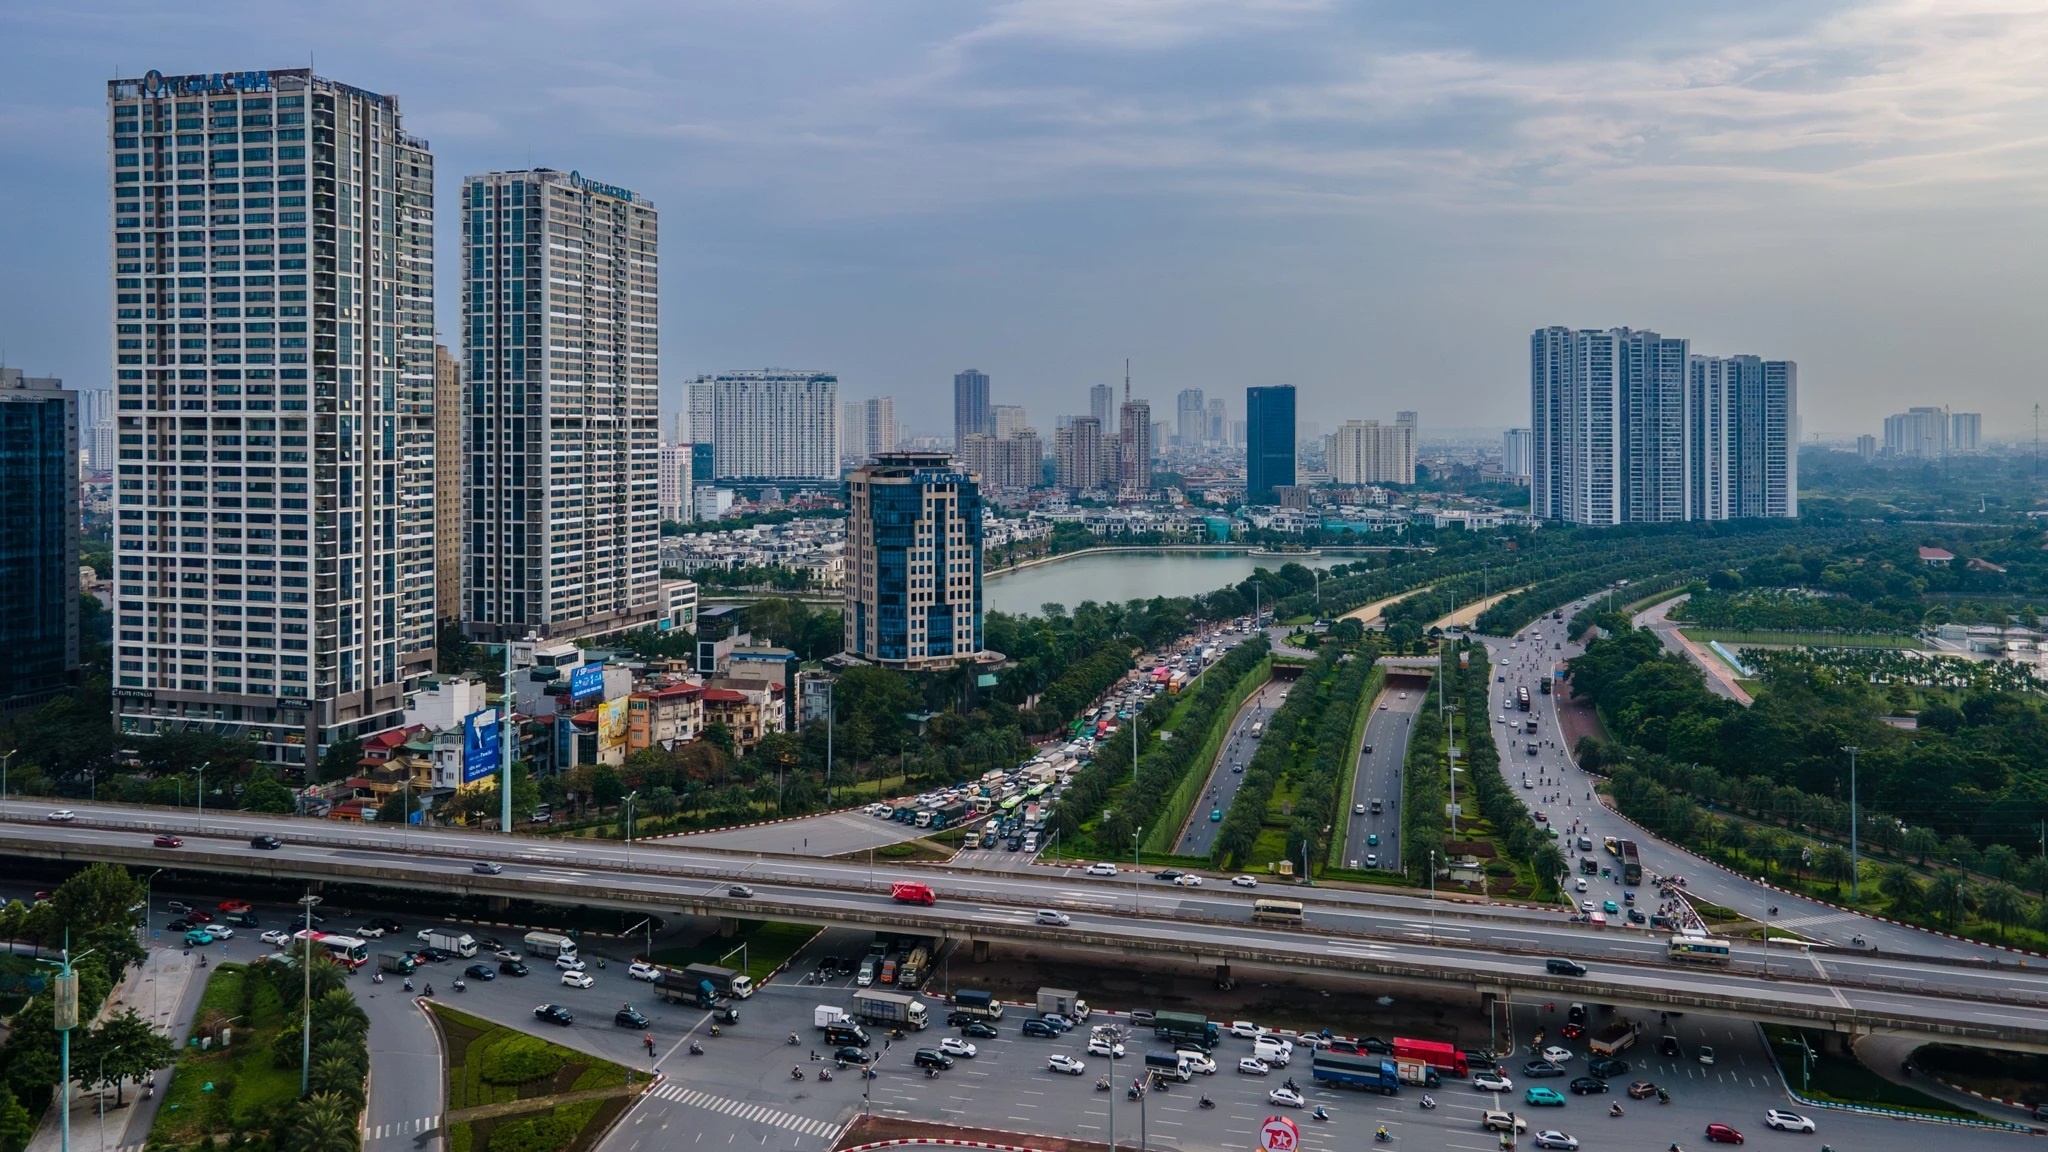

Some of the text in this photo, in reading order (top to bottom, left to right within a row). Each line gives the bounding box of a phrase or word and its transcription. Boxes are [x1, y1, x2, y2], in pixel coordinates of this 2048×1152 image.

[165, 70, 270, 93] VIGLACERA
[581, 178, 632, 202] VIGLACERA
[910, 473, 971, 484] VIGLACERA
